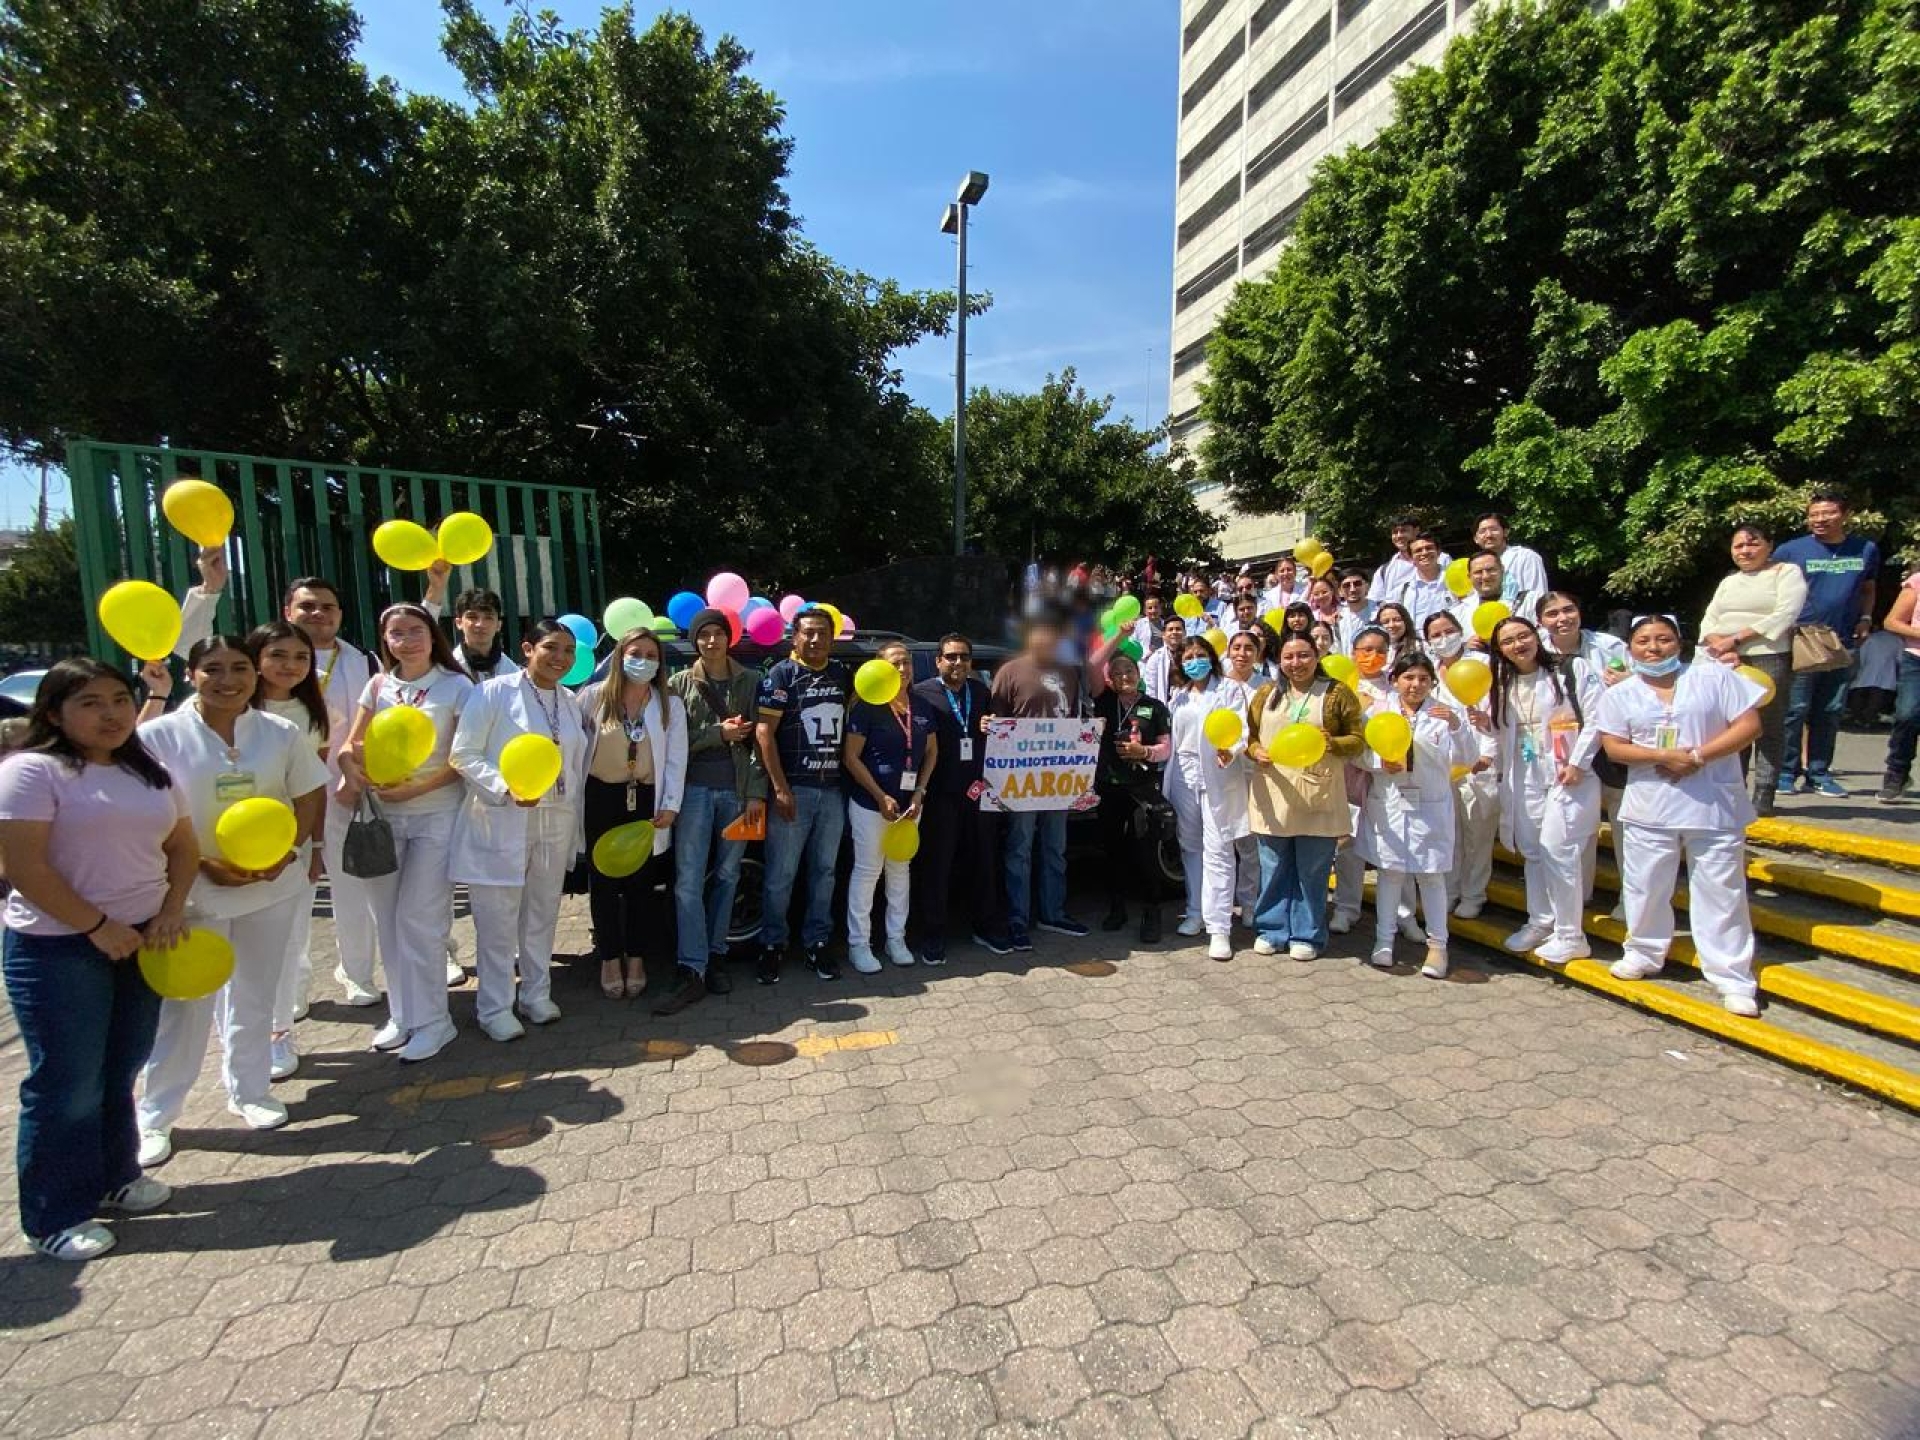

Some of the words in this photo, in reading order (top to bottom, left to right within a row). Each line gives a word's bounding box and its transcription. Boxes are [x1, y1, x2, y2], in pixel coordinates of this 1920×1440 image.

[1034, 722, 1054, 733] MI
[1016, 739, 1076, 752] ÚLTIMA
[985, 755, 1097, 769] QUIMIOTERAPIA
[1001, 769, 1090, 799] AARÓN
